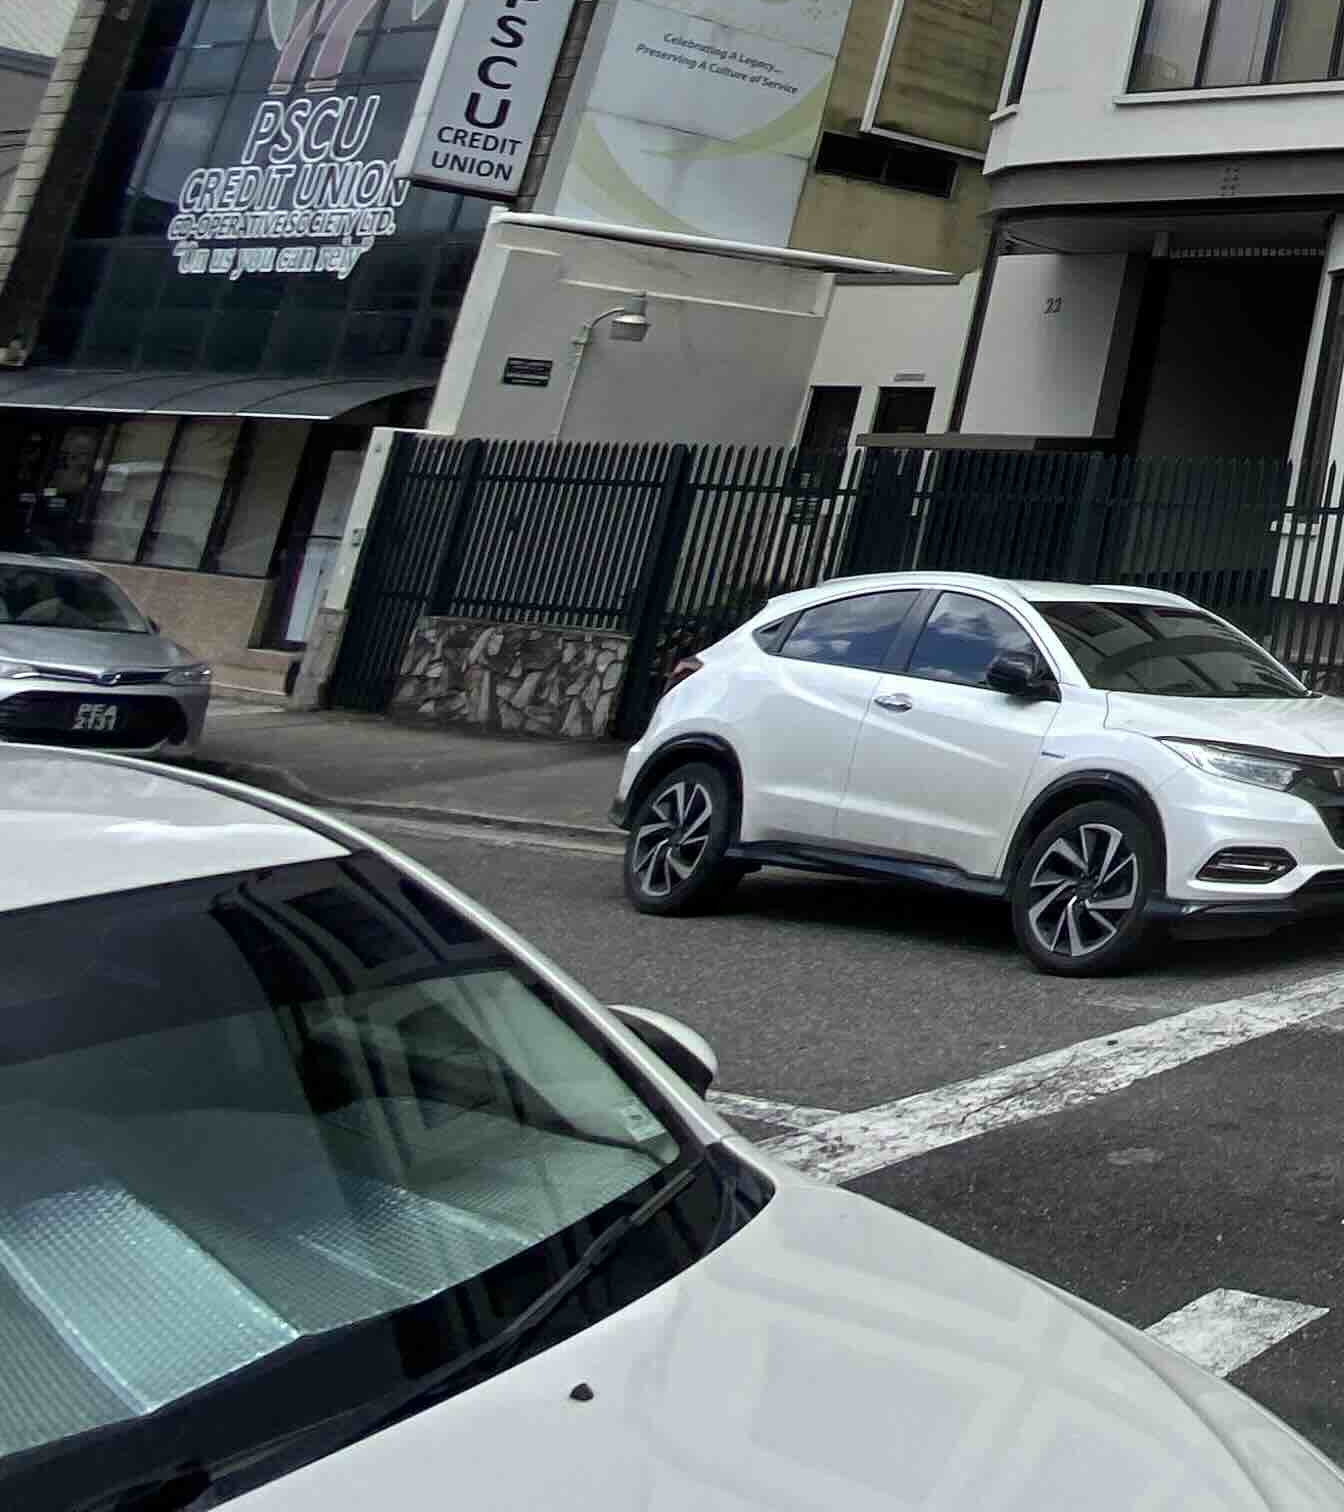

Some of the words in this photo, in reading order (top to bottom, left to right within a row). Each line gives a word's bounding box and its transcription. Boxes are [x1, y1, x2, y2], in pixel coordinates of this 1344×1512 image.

[636, 43, 697, 70] Preserving
[697, 60, 707, 71] A
[708, 63, 748, 82] Culture
[760, 75, 799, 95] Service
[728, 51, 738, 60] A
[240, 95, 381, 165] PSCU
[437, 125, 523, 156] CREDIT
[431, 150, 513, 181] UNION
[178, 164, 297, 213] CREDIT
[292, 159, 410, 210] UNION
[285, 207, 358, 238] SOCIETY
[354, 207, 396, 237] LTD.
